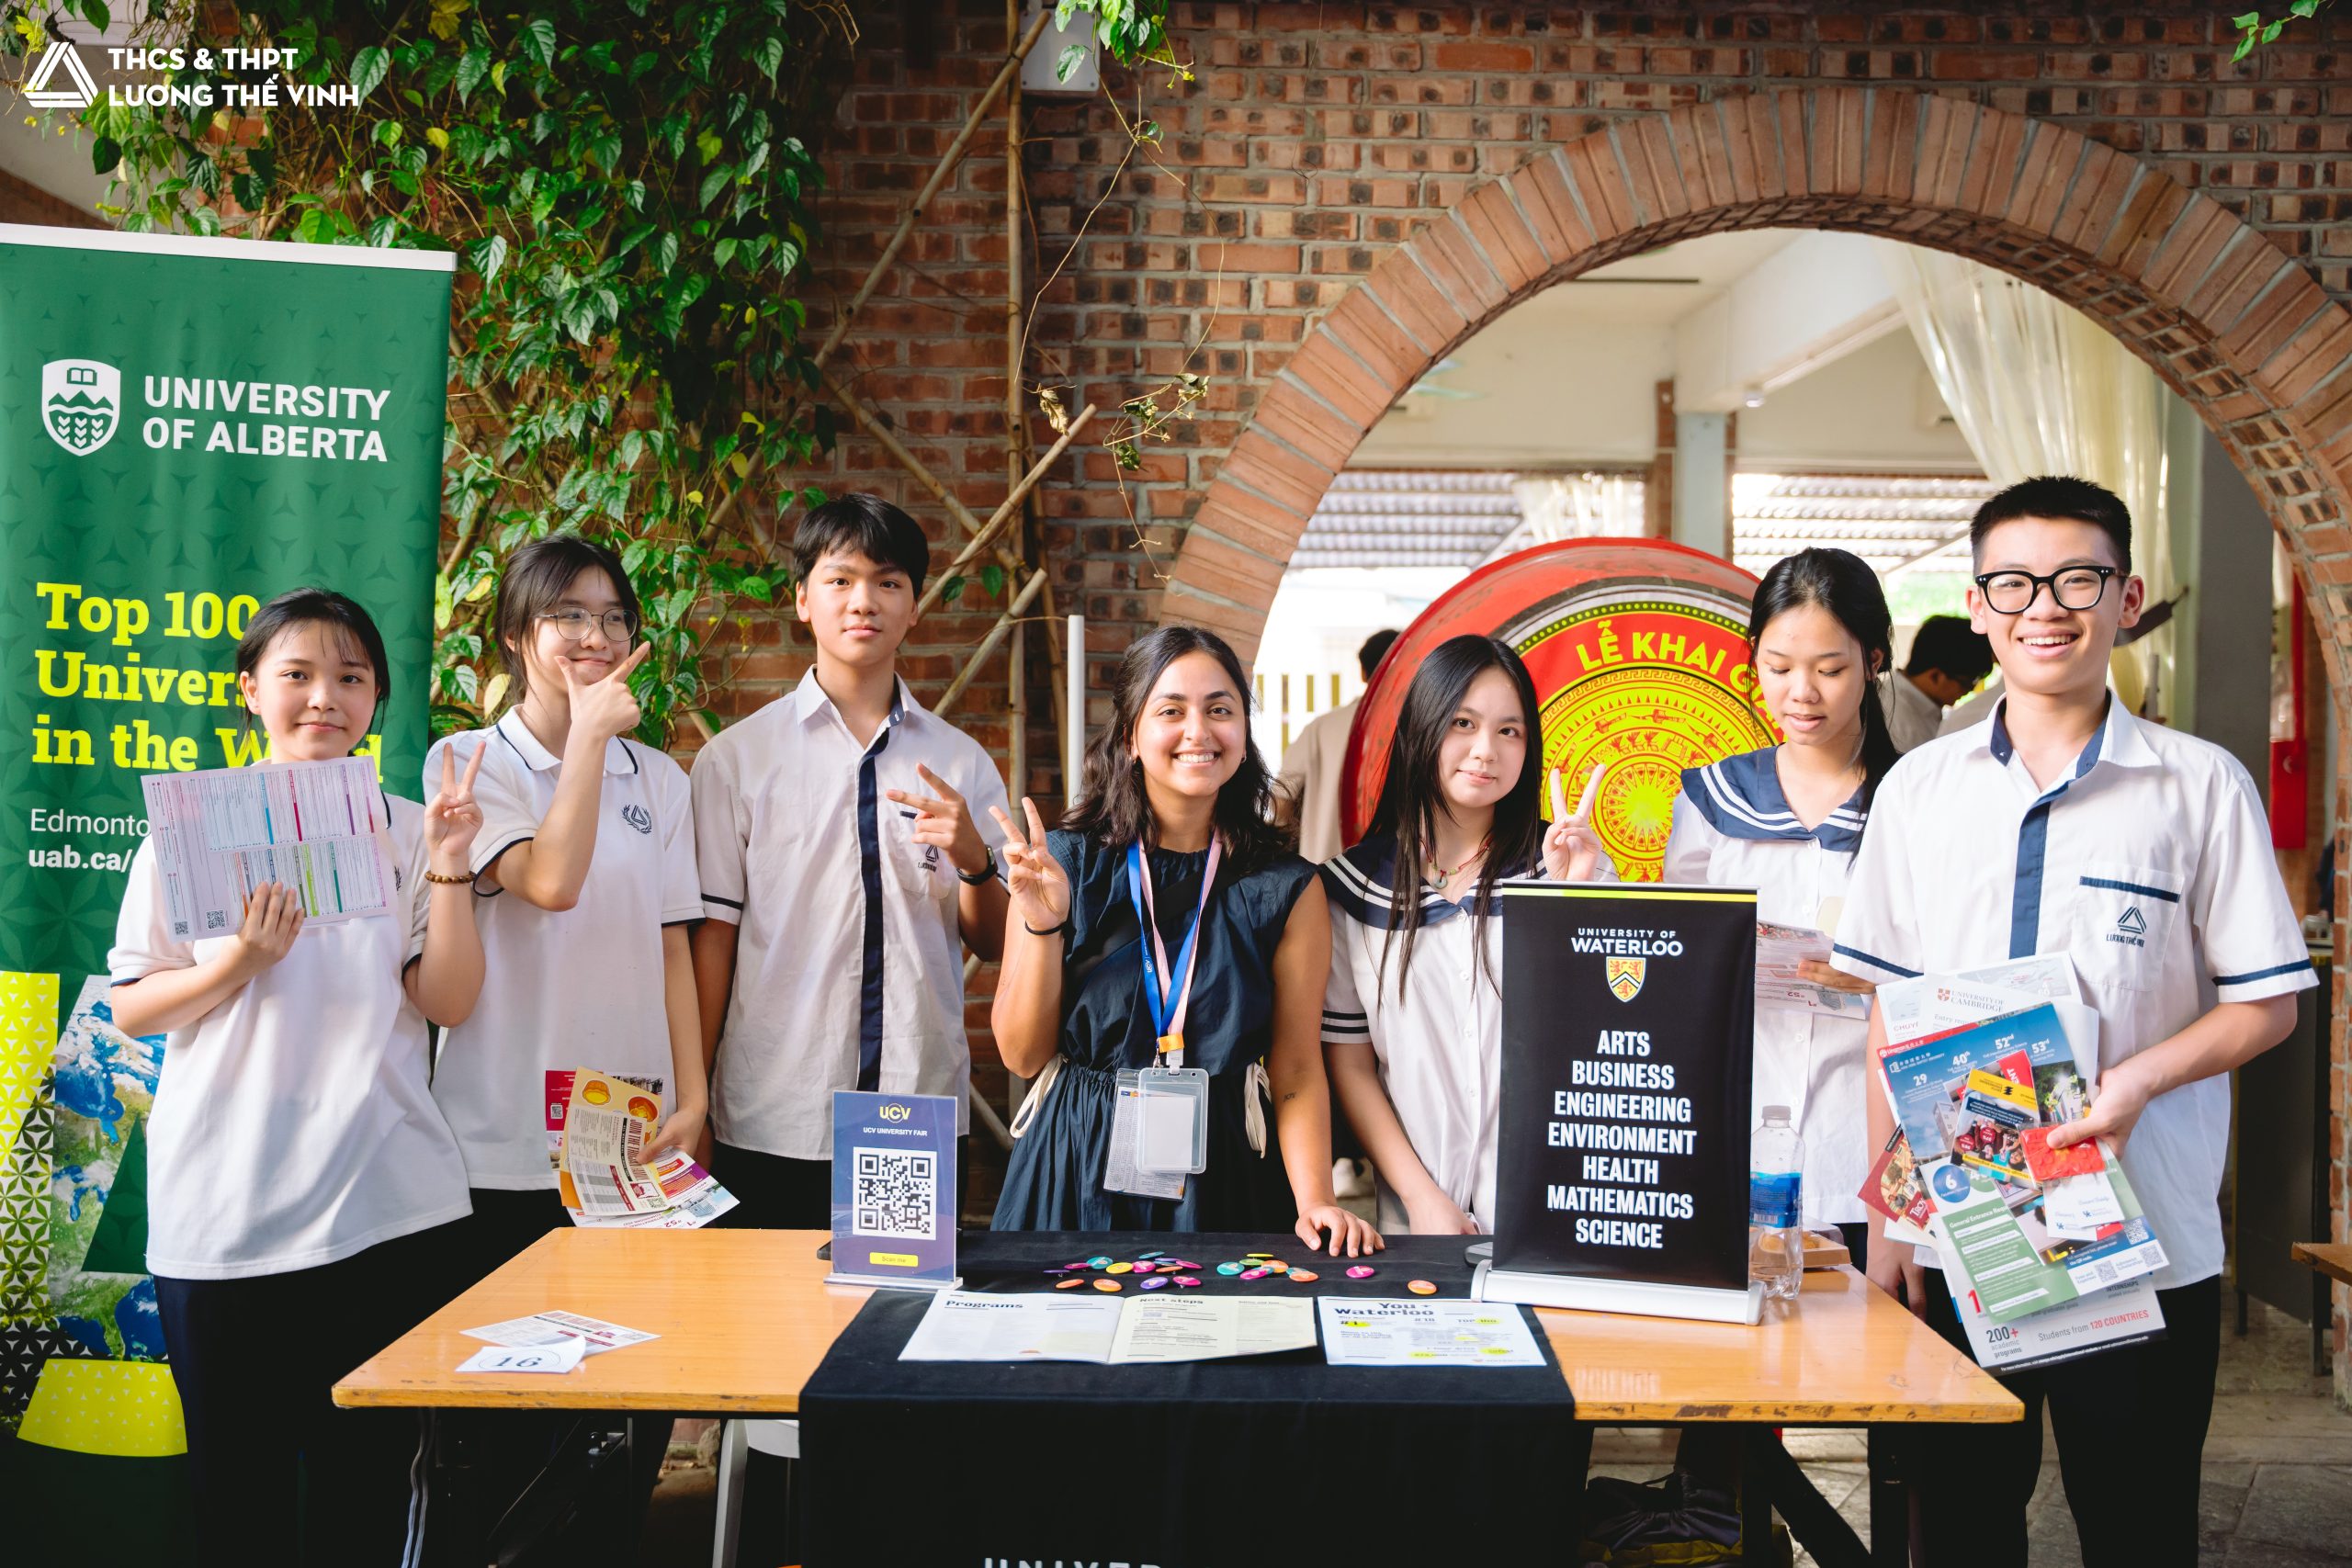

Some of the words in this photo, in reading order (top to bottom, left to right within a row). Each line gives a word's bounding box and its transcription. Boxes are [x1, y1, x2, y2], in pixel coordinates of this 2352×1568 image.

[144, 375, 390, 421] UNIVERSITY
[142, 416, 195, 450] OF
[205, 421, 388, 462] ALBERTA
[36, 581, 150, 647] Top
[164, 591, 260, 641] 100
[1576, 619, 1623, 671] LỄ
[1632, 631, 1727, 676] KHAI
[32, 714, 96, 766] in
[109, 718, 198, 773] the
[1570, 937, 1684, 956] WATERLOO
[1577, 928, 1654, 938] UNIVERSITY
[1660, 930, 1676, 939] OF
[1597, 1030, 1651, 1056] ARTS
[1571, 1060, 1676, 1090] BUSINESS
[1913, 1073, 1928, 1087] 29
[879, 1106, 911, 1120] UCV
[1554, 1090, 1691, 1122] ENGINEERING
[1547, 1122, 1698, 1156] ENVIRONMENT
[1582, 1155, 1660, 1184] HEALTH
[1945, 1174, 1957, 1190] 6
[1546, 1184, 1694, 1219] MATHEMATICS
[1575, 1217, 1664, 1249] SCIENCE
[945, 1300, 1023, 1309] Programs
[1985, 1326, 2019, 1343] 200+
[2038, 1328, 2071, 1341] Students
[2071, 1325, 2089, 1335] from
[2089, 1320, 2103, 1330] 120
[2104, 1309, 2150, 1326] COUNTRIES
[1991, 1339, 2020, 1351] academic
[1994, 1348, 2022, 1359] programs
[494, 1357, 542, 1368] 16
